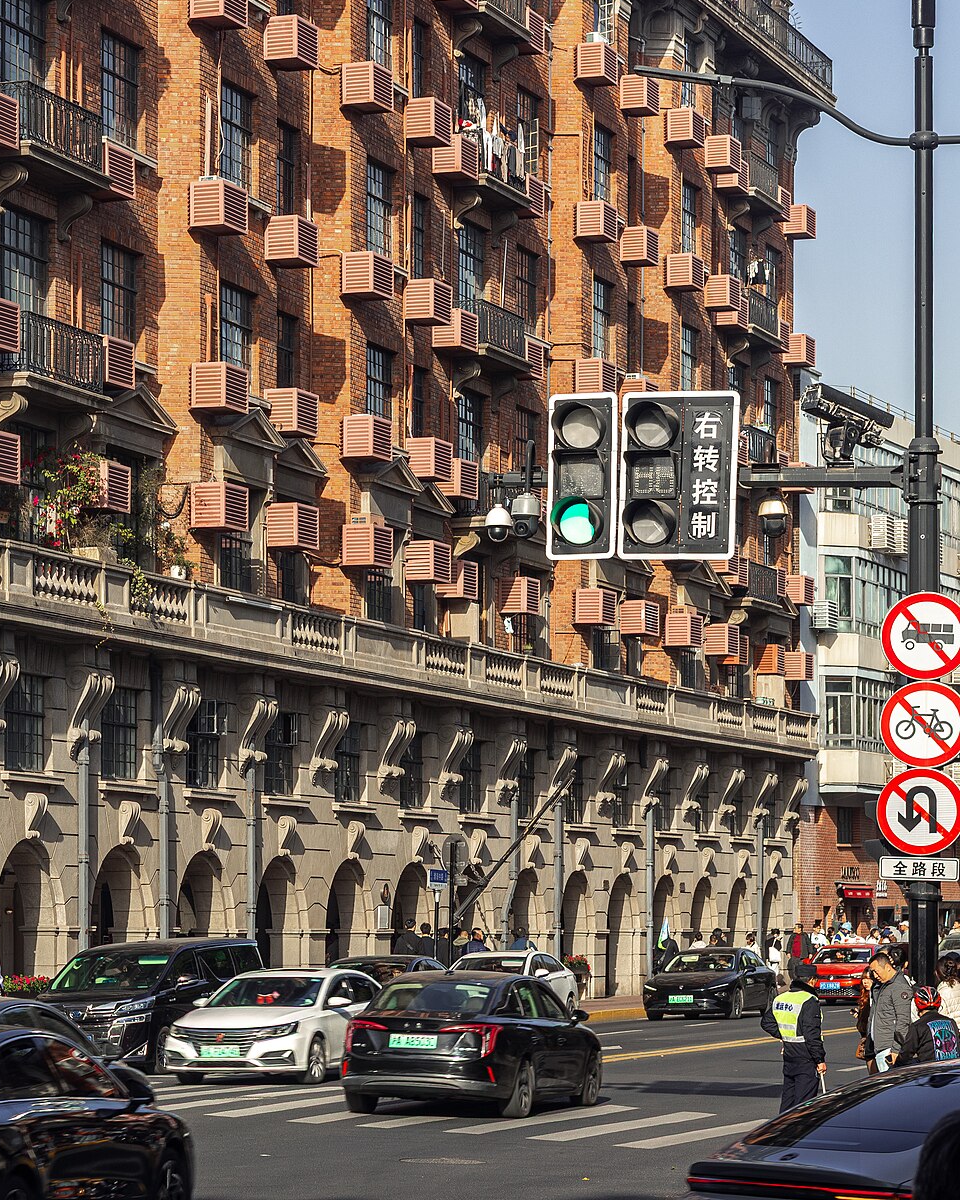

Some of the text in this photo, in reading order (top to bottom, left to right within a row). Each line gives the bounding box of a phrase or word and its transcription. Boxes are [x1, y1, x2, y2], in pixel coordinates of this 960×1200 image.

[691, 412, 721, 538] 右转控制
[893, 861, 946, 877] 全路段
